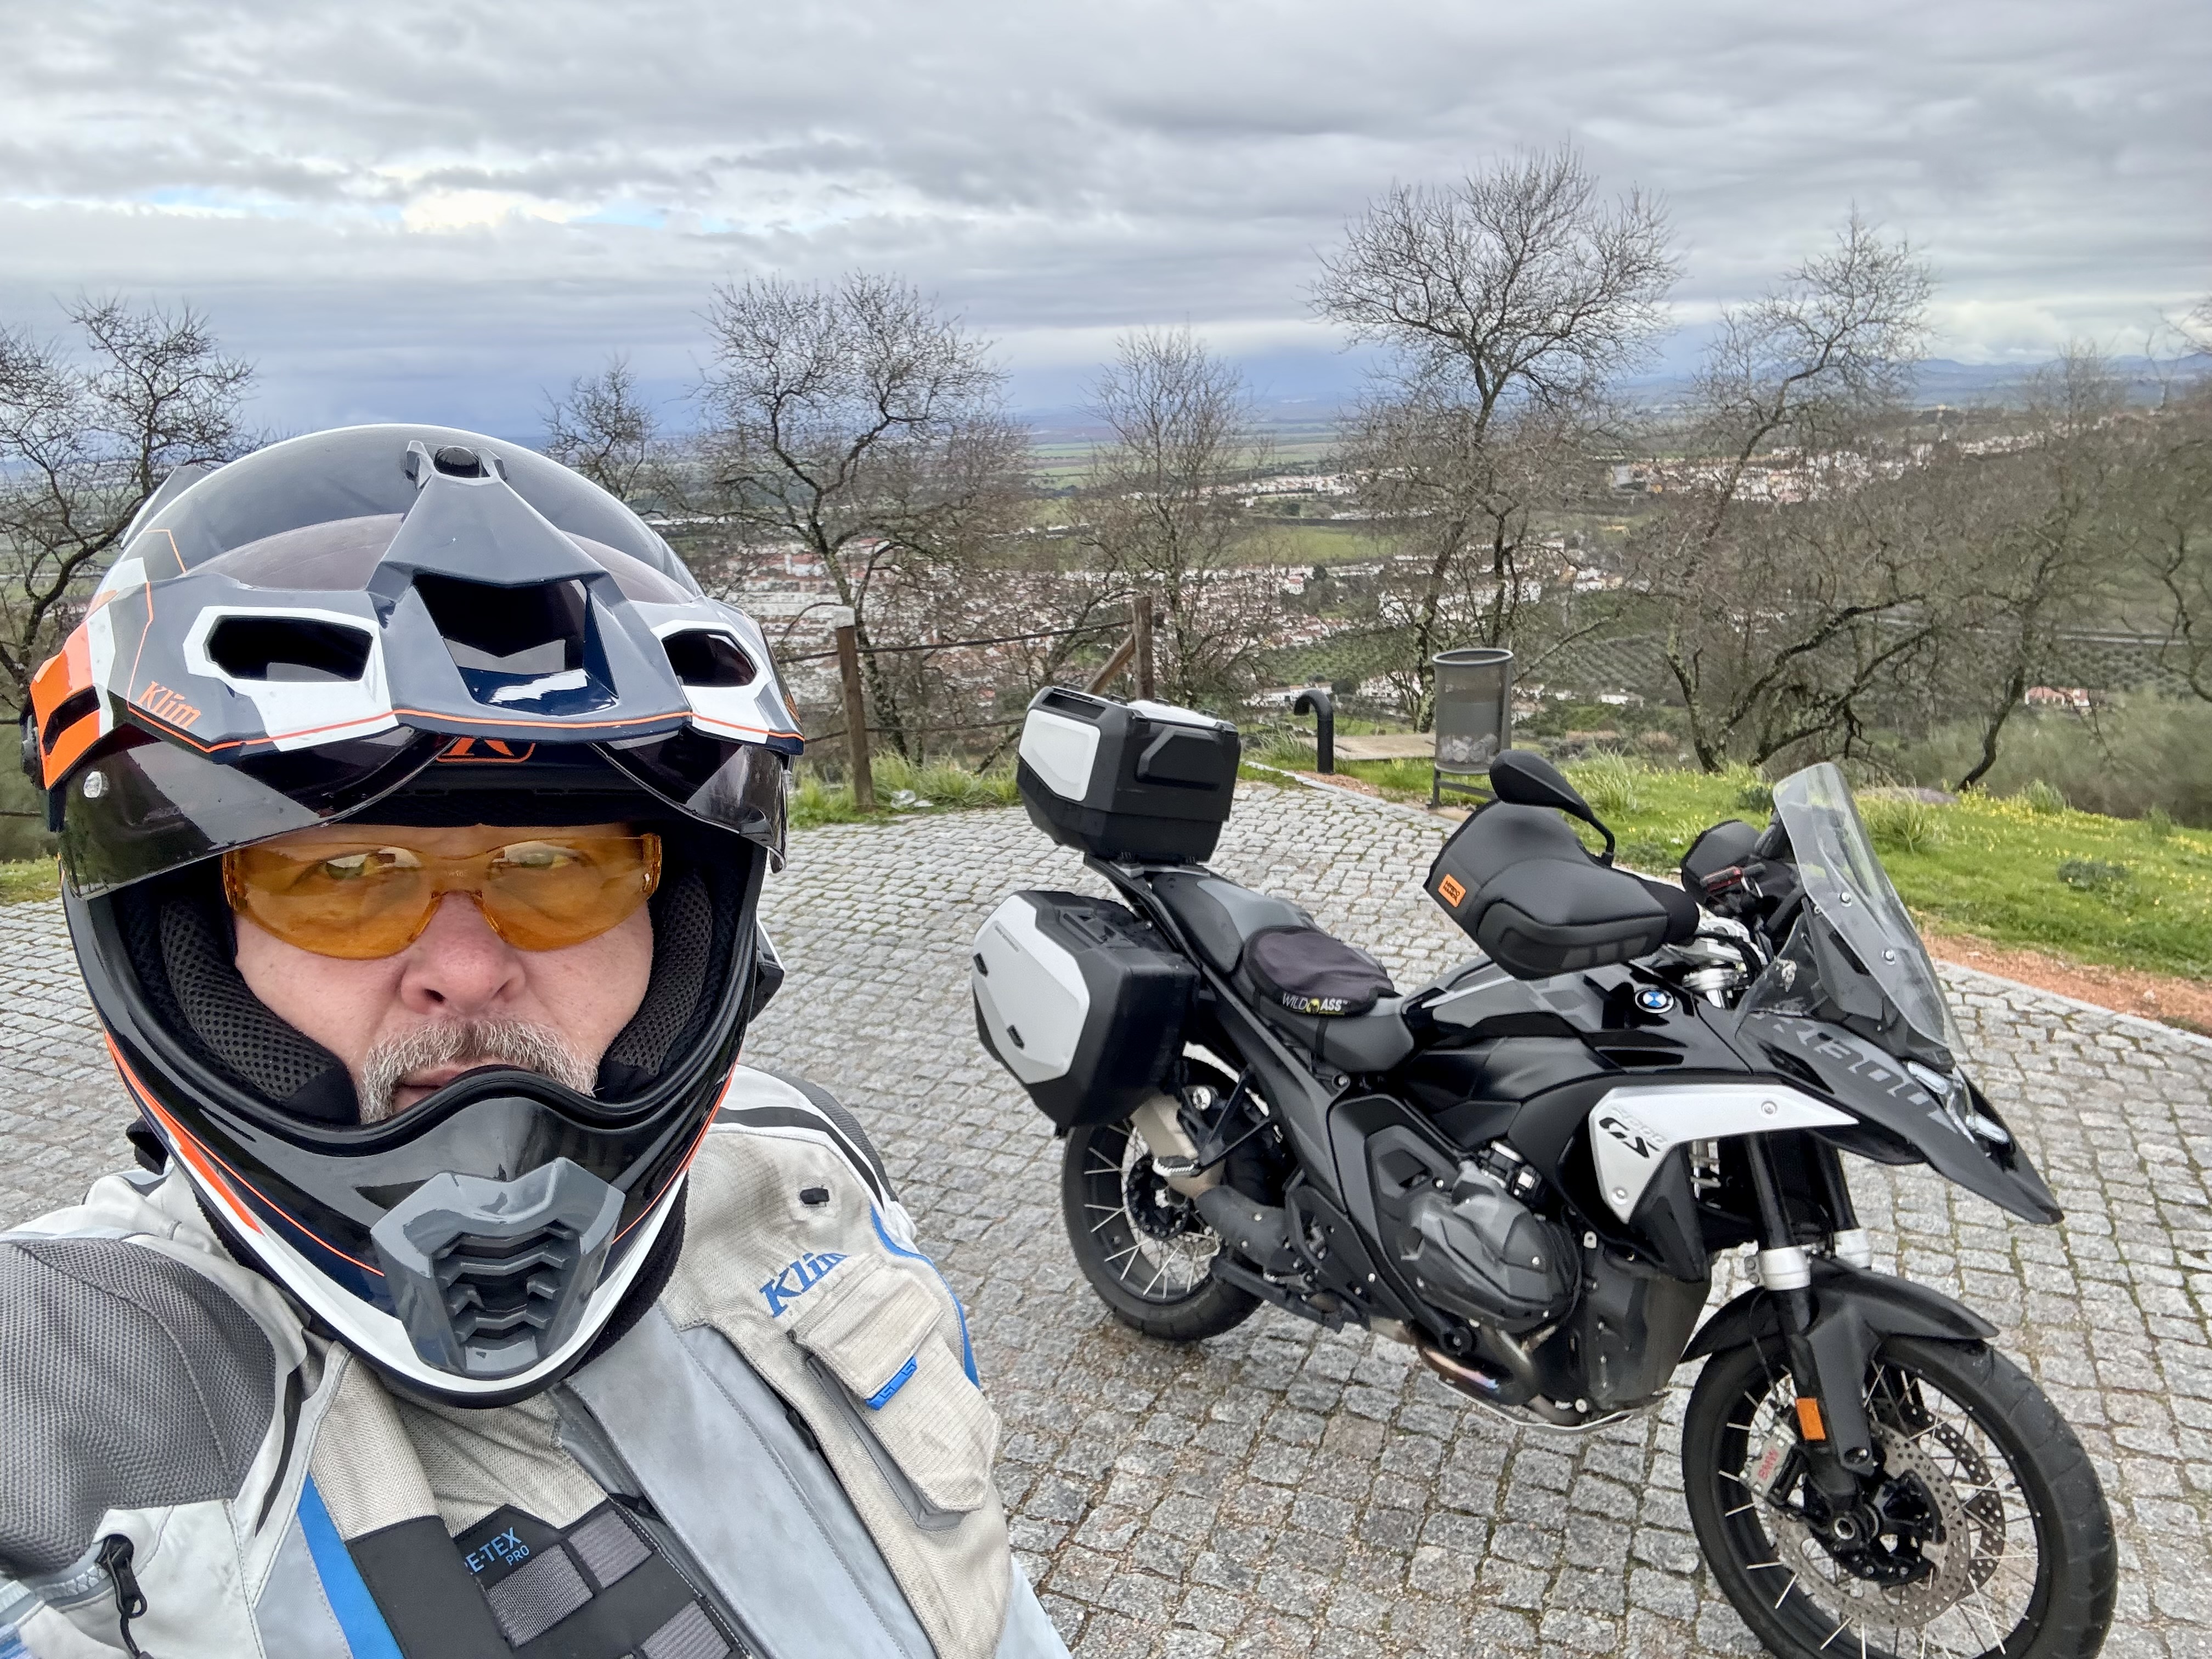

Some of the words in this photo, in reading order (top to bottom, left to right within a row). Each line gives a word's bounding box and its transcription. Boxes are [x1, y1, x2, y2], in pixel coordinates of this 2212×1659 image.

[136, 681, 201, 729] Klim
[1283, 992, 1308, 1010] WILD
[464, 1527, 522, 1574] E-TEX
[505, 1545, 529, 1566] PRO
